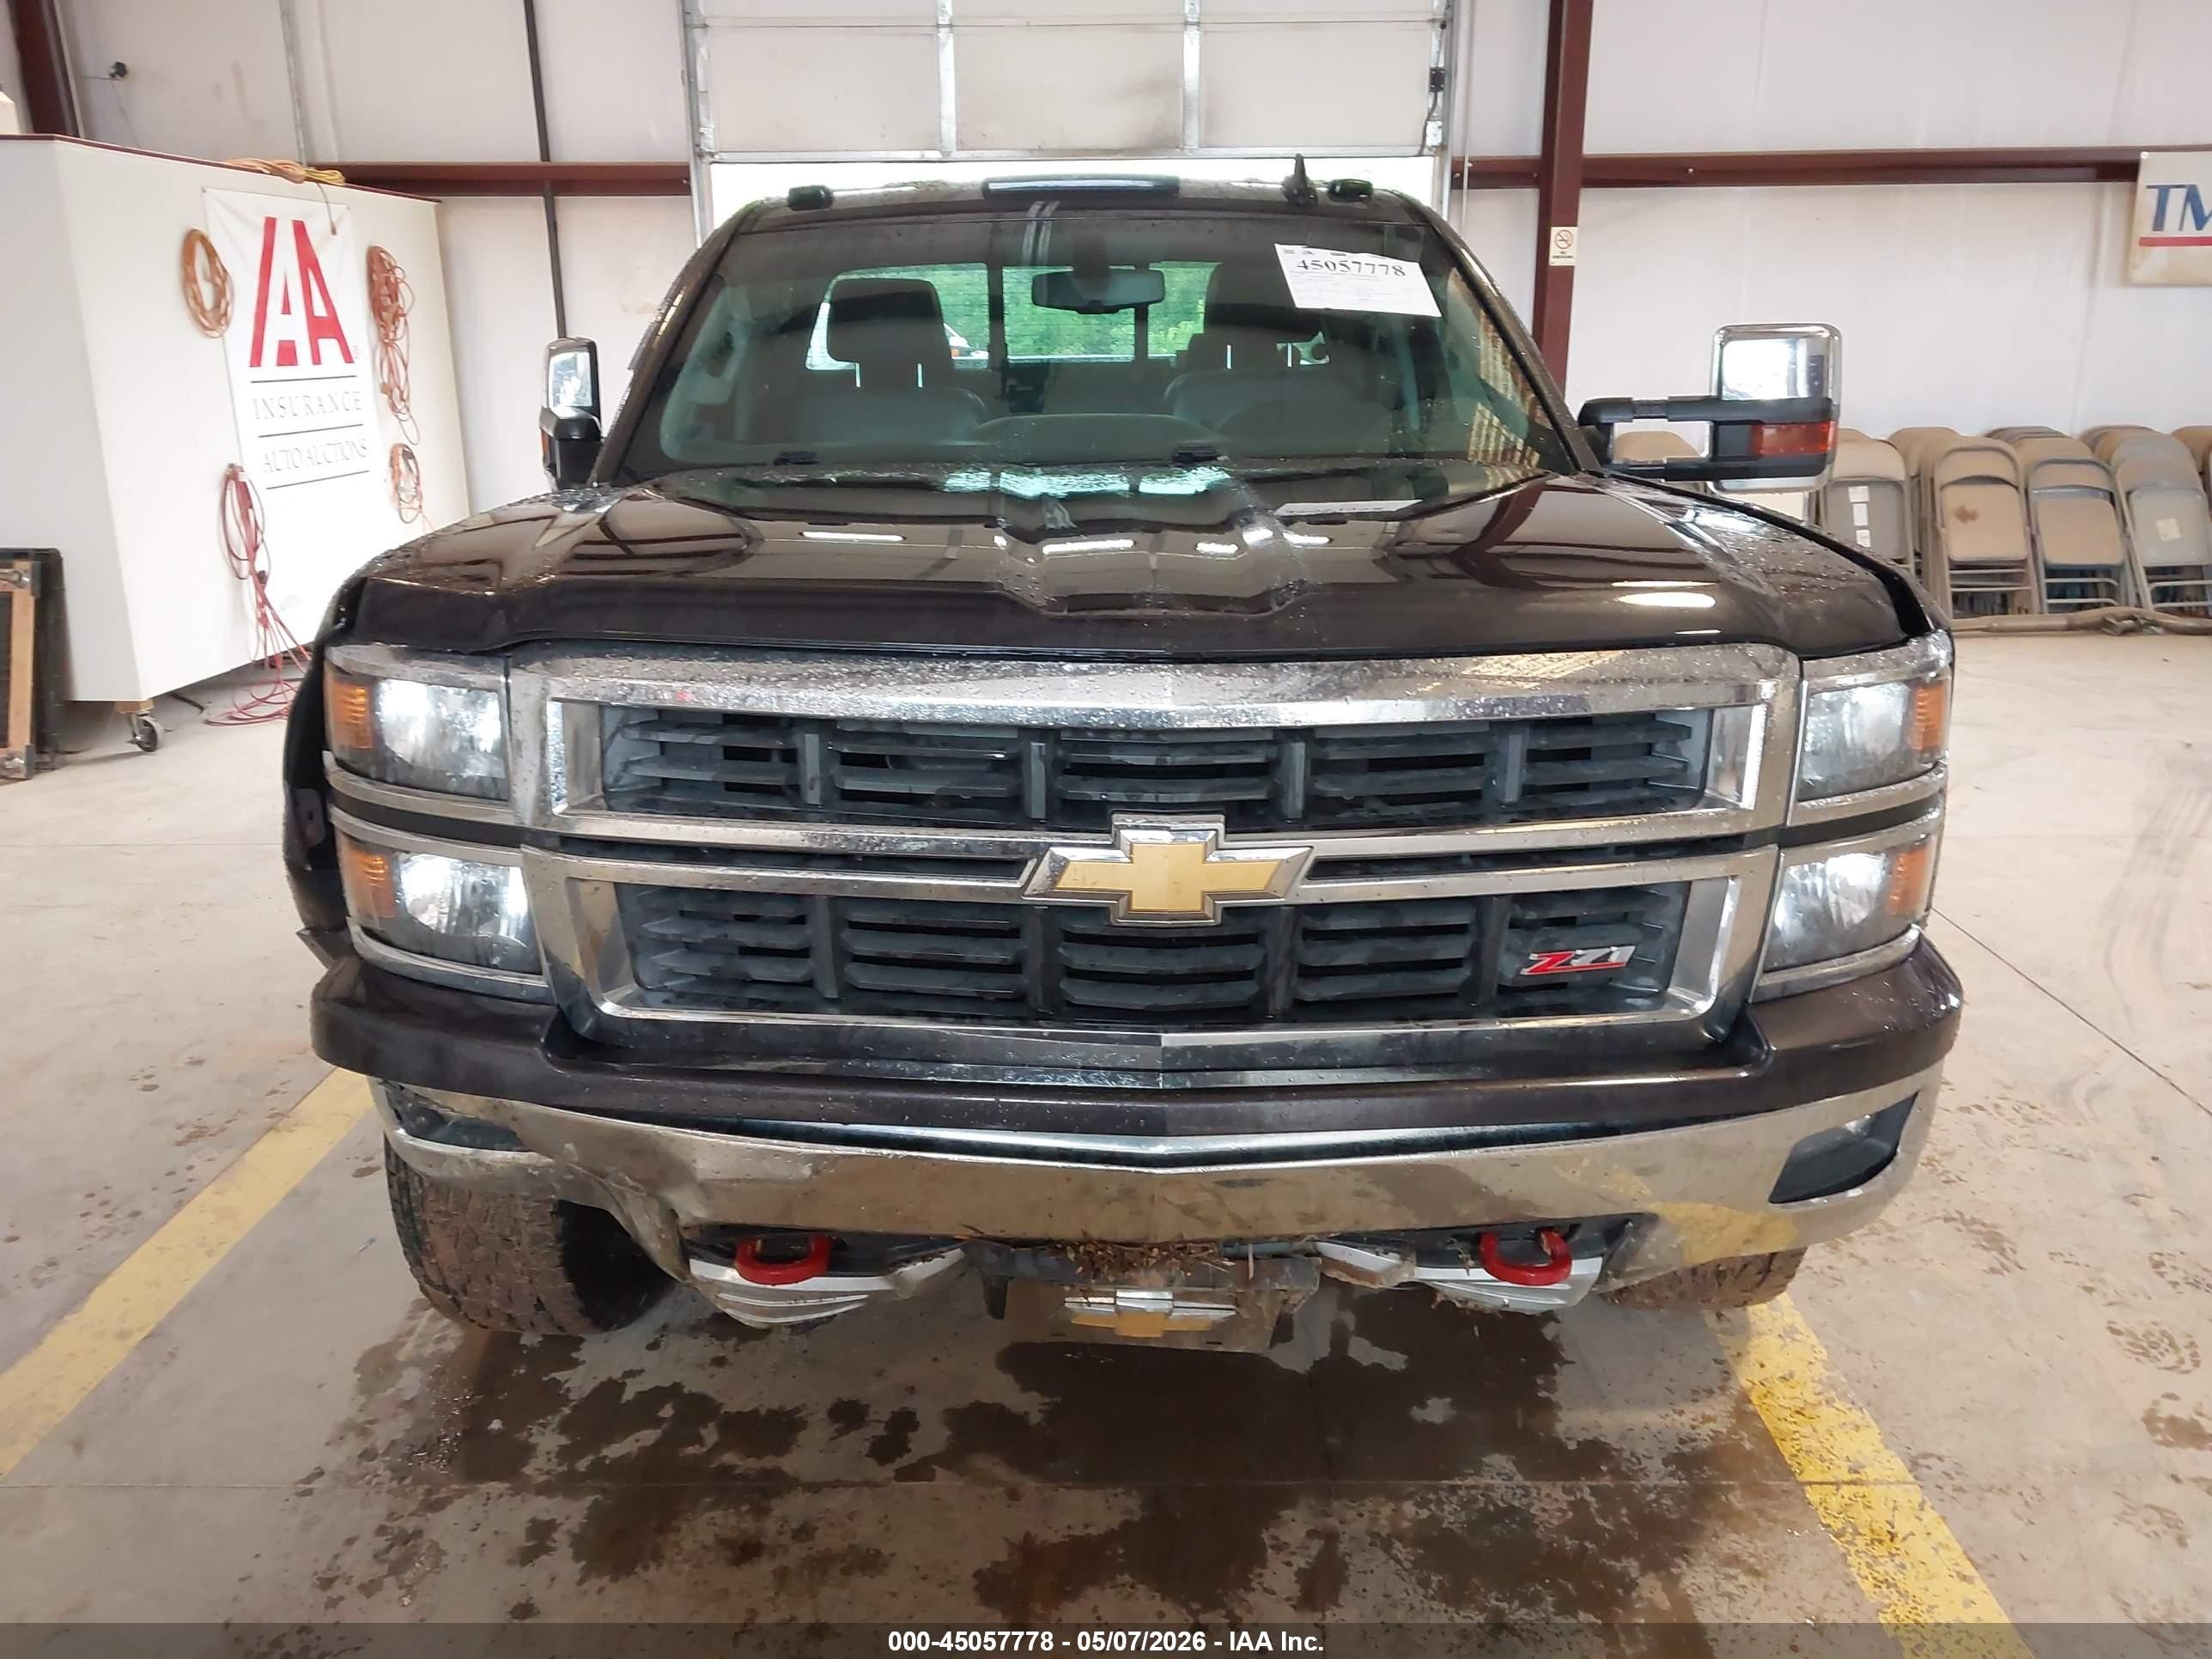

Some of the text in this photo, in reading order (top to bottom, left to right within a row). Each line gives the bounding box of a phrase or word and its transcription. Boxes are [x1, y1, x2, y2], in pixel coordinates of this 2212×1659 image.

[1296, 259, 1407, 276] 45057778
[251, 391, 363, 420] INSURANCE
[262, 438, 369, 473] AUTO AUCTIONS
[1519, 945, 1636, 975] Z71
